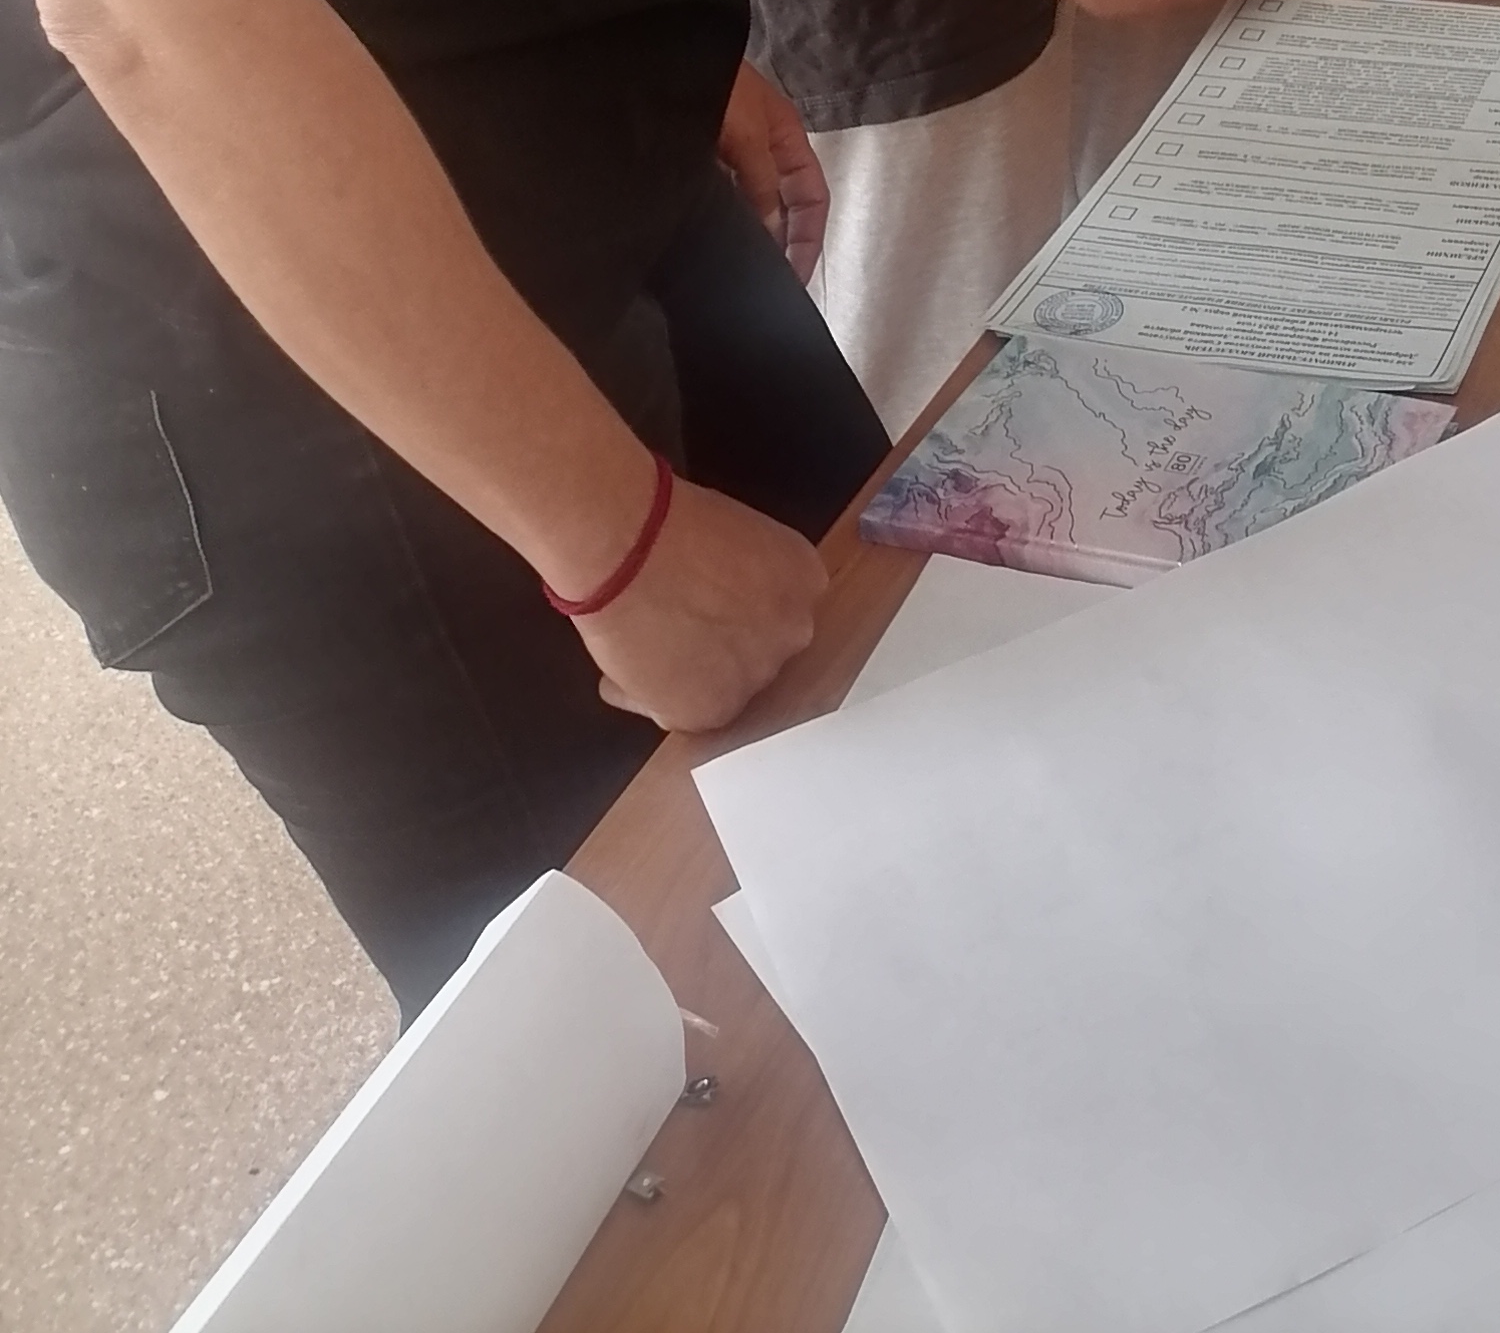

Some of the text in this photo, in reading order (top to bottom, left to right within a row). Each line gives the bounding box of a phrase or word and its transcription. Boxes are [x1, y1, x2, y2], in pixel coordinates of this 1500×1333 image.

[1100, 477, 1161, 520] Today
[1147, 435, 1176, 455] the
[1164, 405, 1212, 431] day
[1171, 454, 1191, 471] 80
